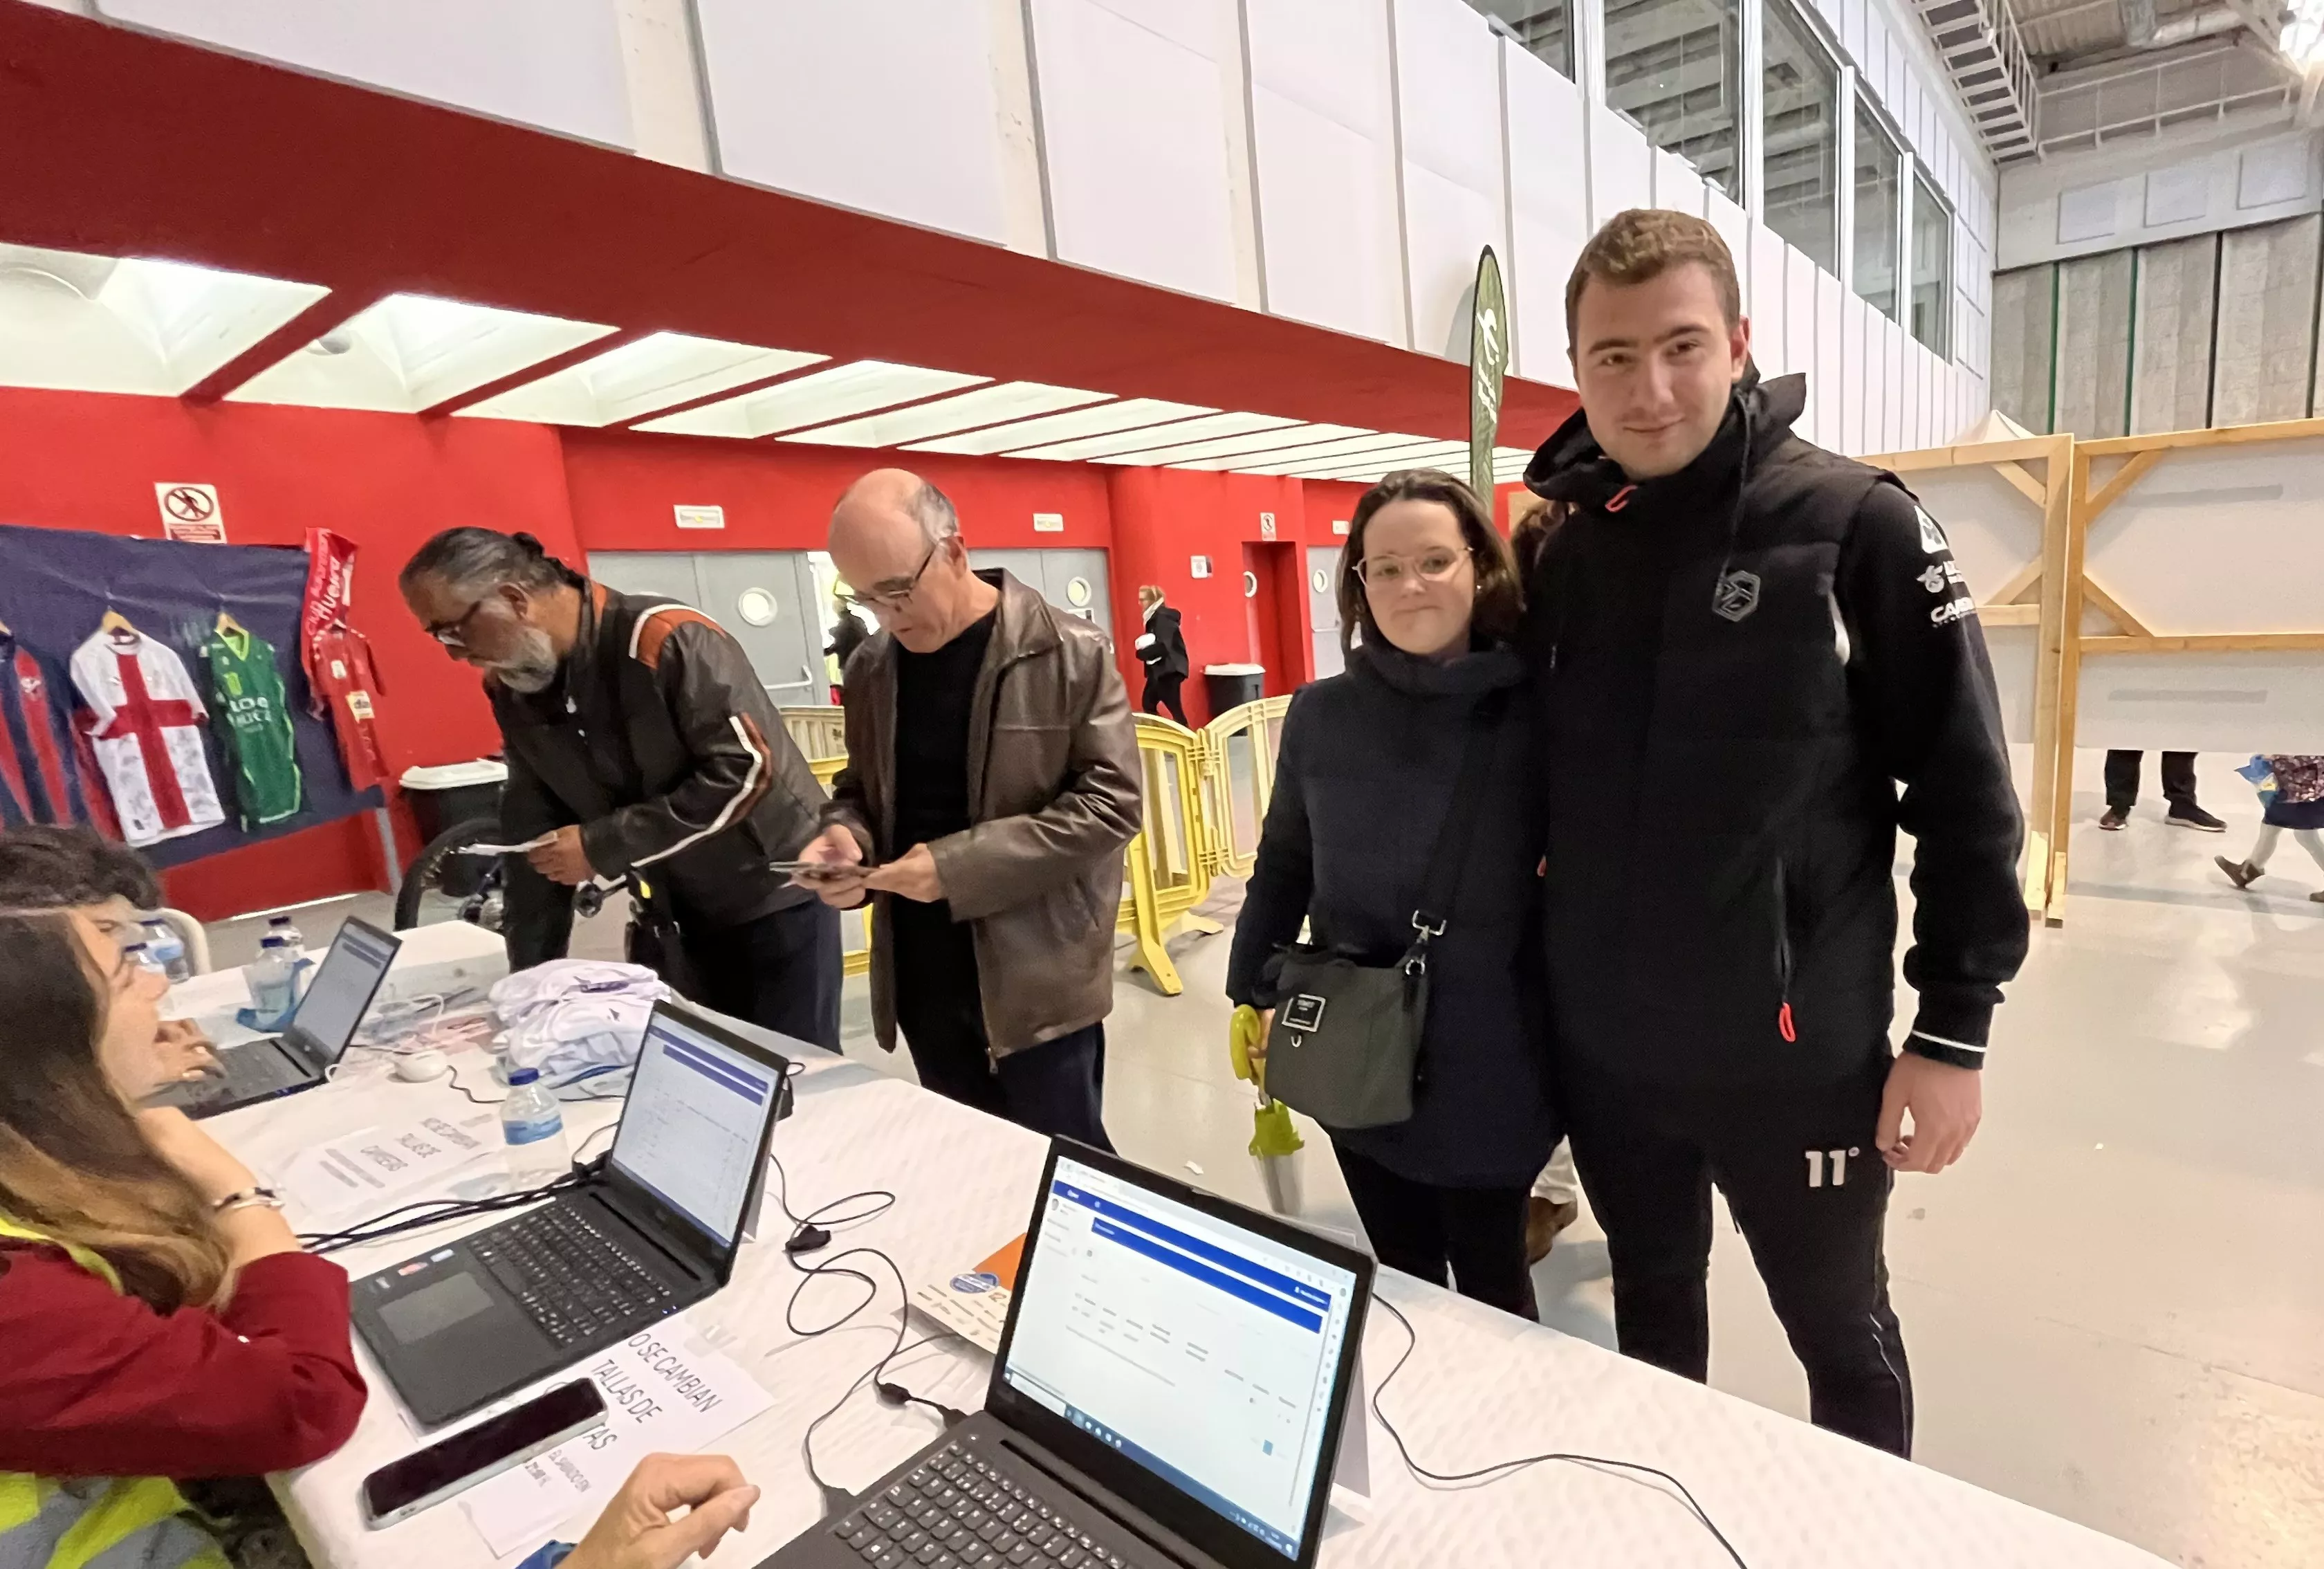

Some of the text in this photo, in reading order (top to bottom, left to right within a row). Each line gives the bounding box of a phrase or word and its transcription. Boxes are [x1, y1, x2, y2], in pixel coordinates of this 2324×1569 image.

[591, 1358, 663, 1424] TALLAS DE
[628, 1332, 723, 1413] O SE CAMBIAN
